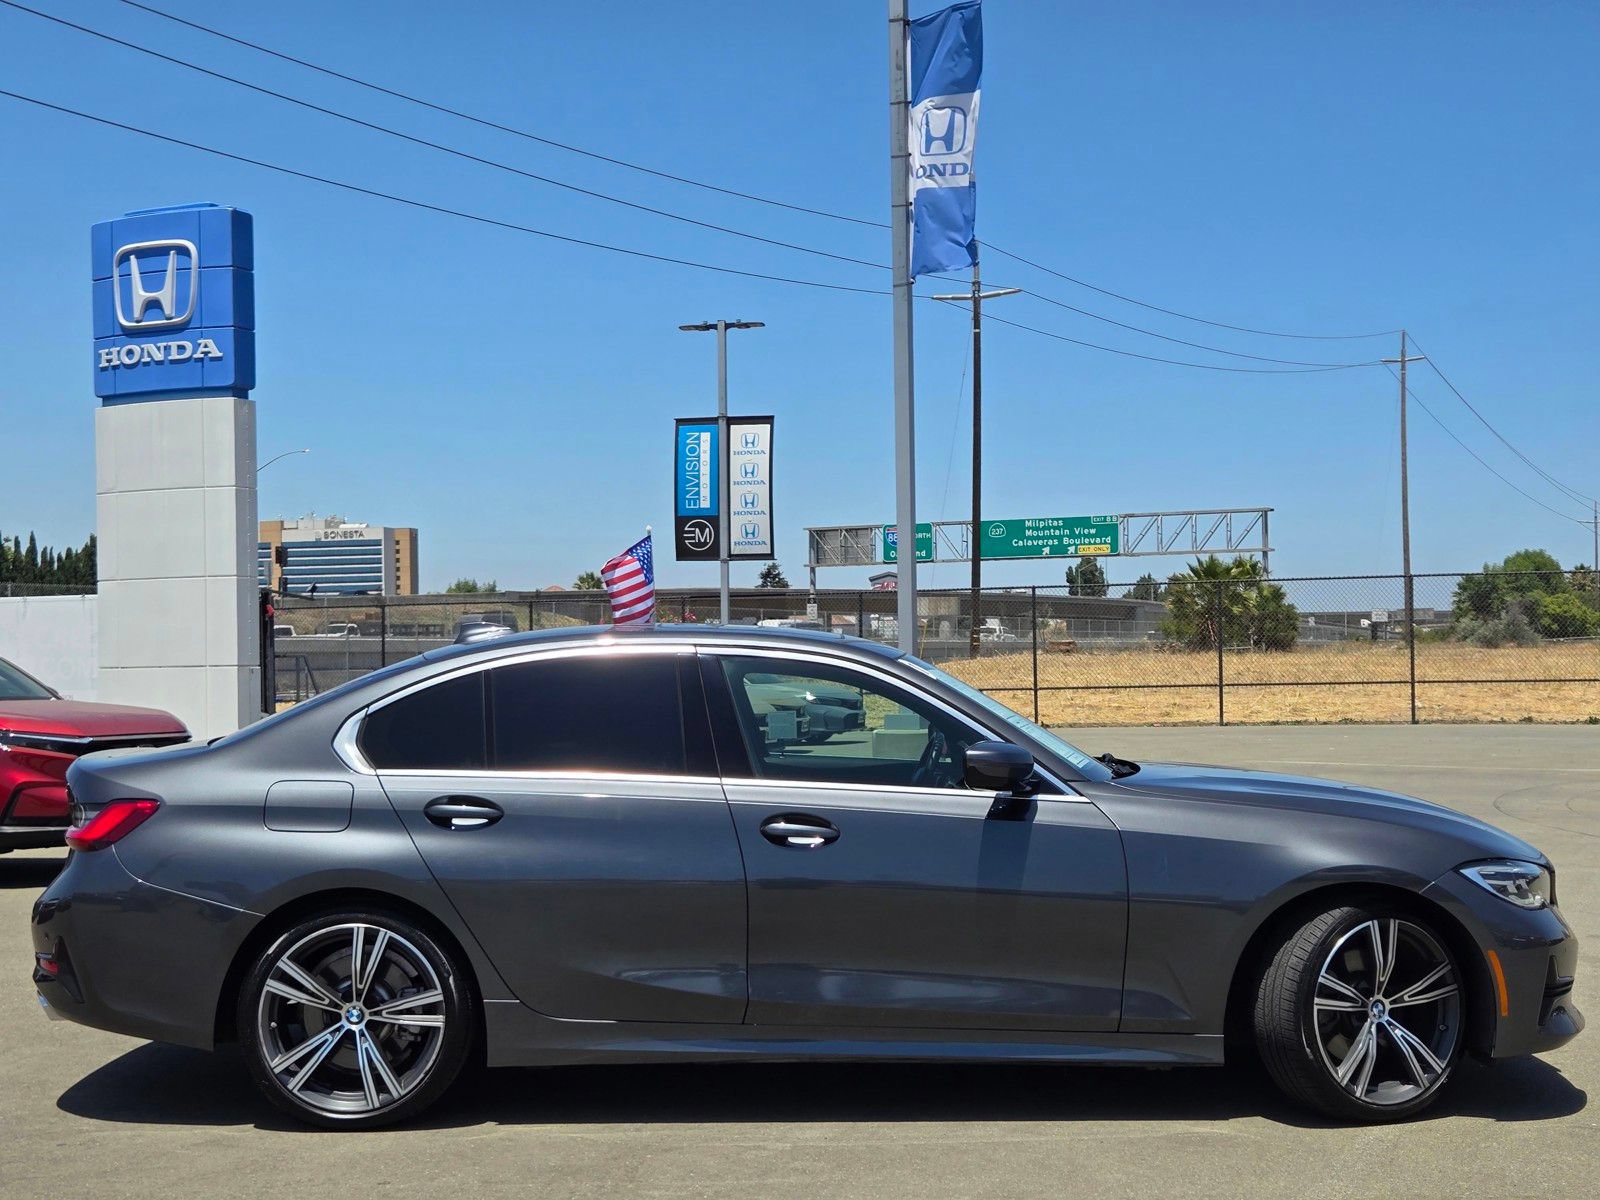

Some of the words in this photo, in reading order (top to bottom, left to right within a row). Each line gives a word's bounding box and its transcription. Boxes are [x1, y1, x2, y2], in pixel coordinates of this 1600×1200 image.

[916, 162, 971, 179] OND
[98, 339, 223, 368] HONDA
[686, 432, 699, 508] ENVISION
[1025, 519, 1064, 529] Milpitas
[323, 530, 365, 539] SONESTA
[991, 528, 1004, 536] 237
[1025, 528, 1070, 537] Mountain
[1074, 527, 1097, 535] View
[1012, 538, 1059, 547] Calaveras
[1063, 535, 1111, 545] Boulevard
